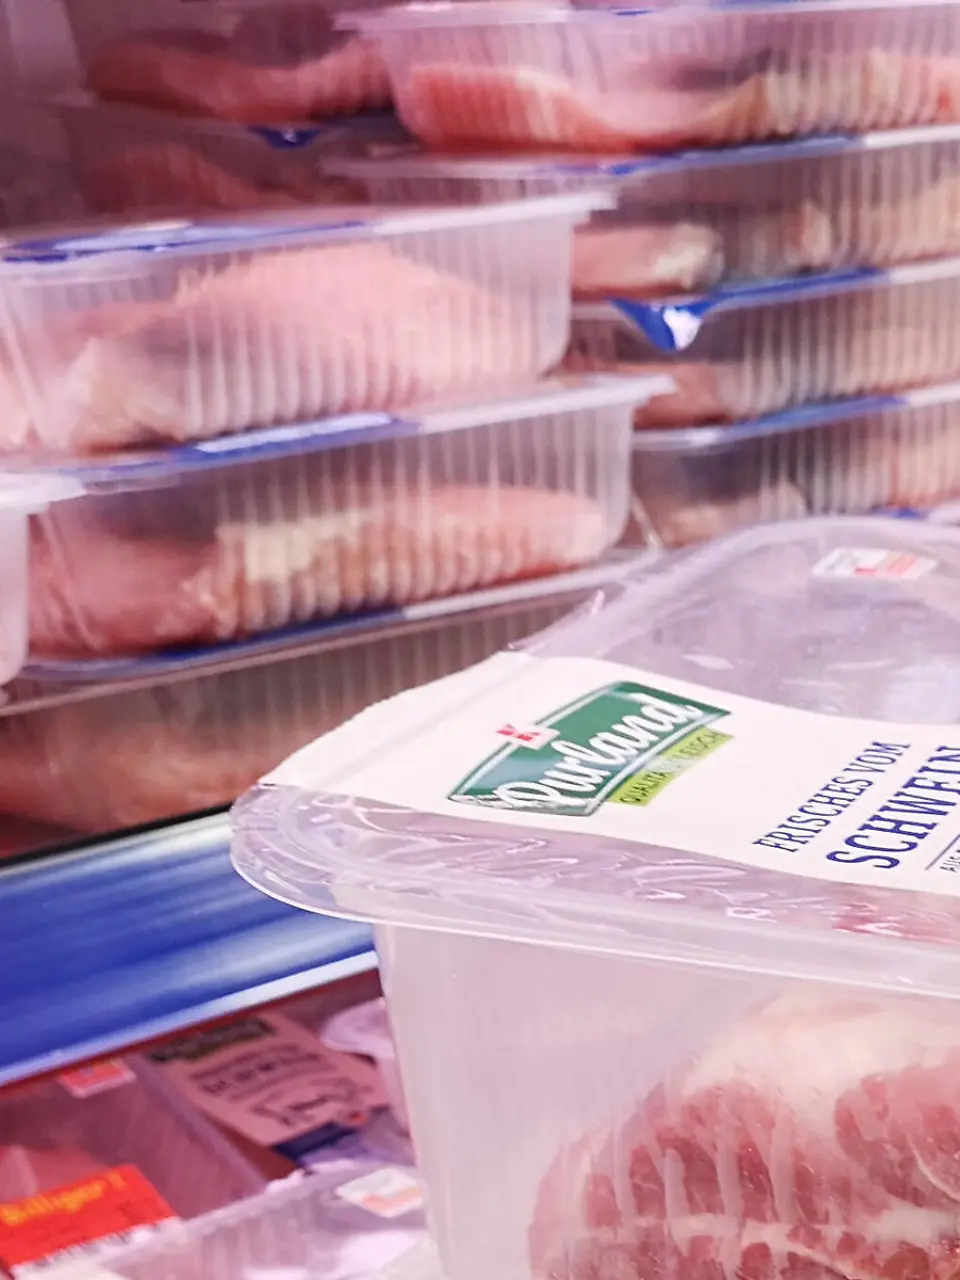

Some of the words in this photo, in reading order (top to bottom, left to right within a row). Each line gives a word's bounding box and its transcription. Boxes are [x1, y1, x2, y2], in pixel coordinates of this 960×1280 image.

[478, 692, 704, 808] Purland
[752, 777, 875, 852] FRISCHES
[842, 740, 911, 774] VOM
